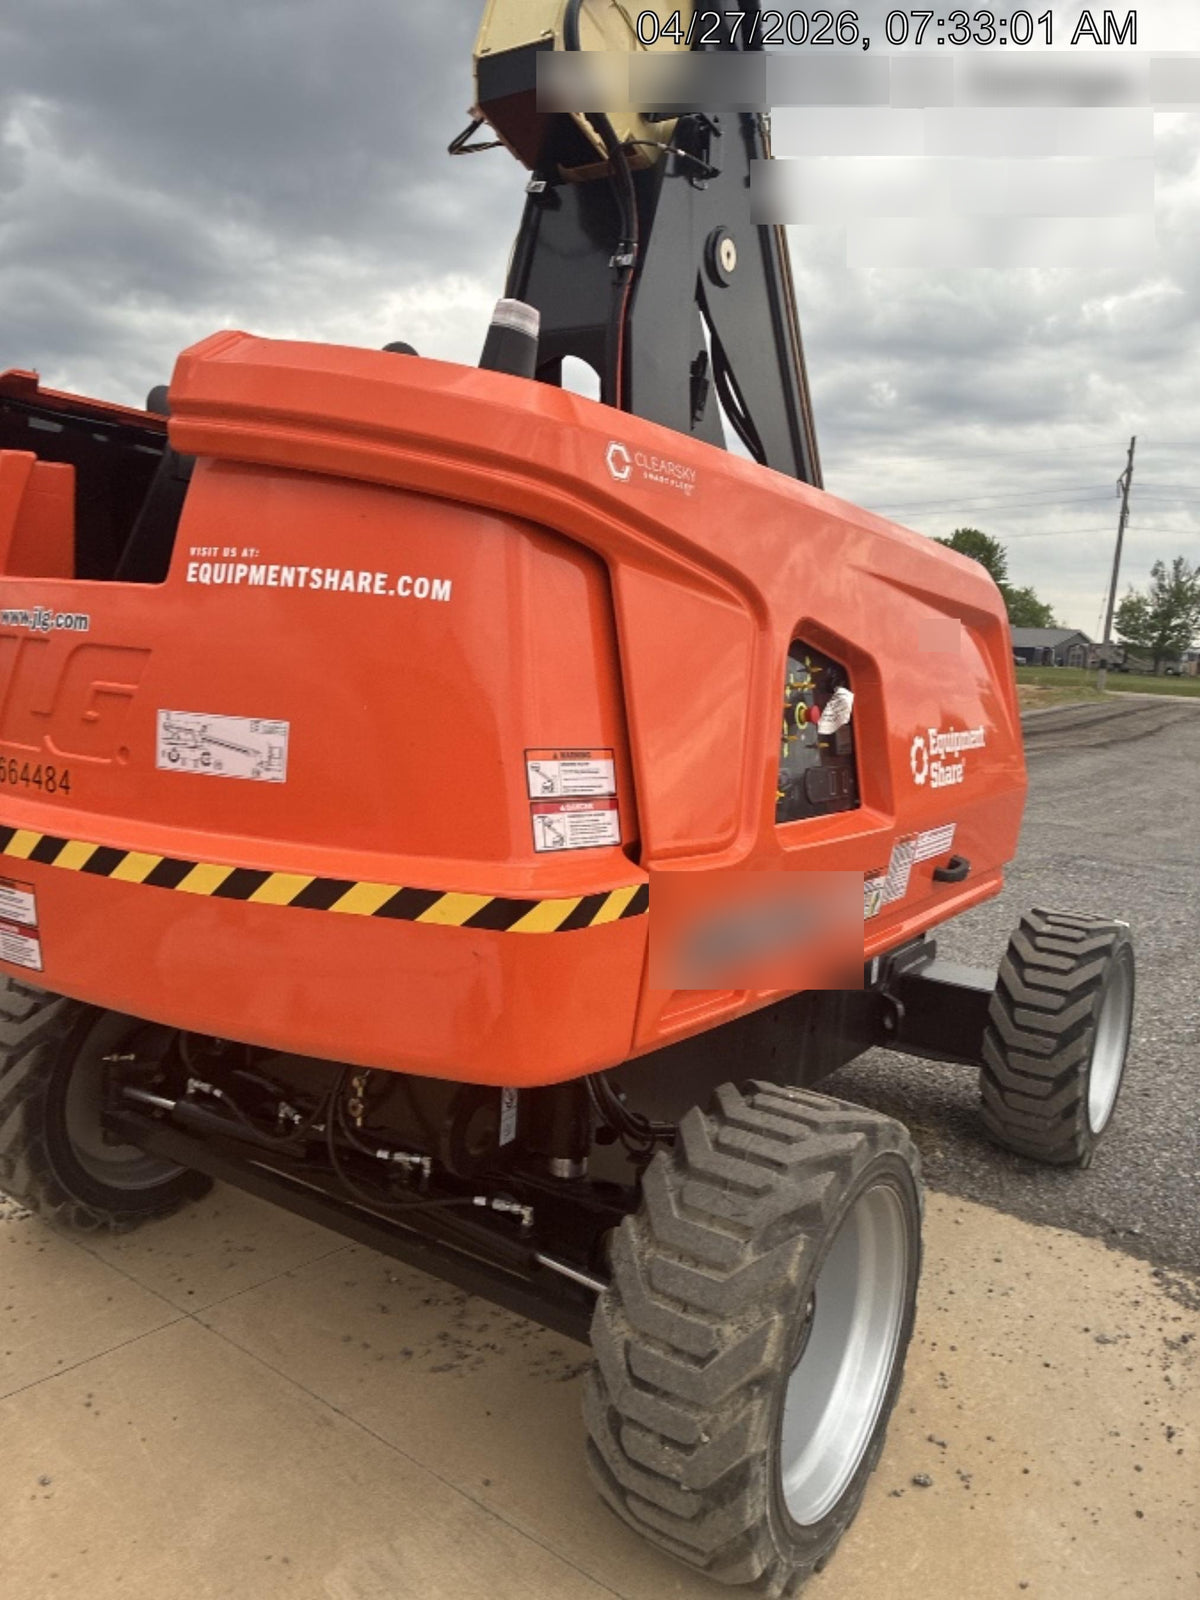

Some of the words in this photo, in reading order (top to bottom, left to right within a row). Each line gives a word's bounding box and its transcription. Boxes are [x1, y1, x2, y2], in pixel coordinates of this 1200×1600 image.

[634, 452, 696, 482] CLEARSKY
[189, 547, 219, 557] VISIT
[223, 547, 237, 557] US
[241, 547, 260, 558] AT:
[186, 561, 452, 602] EQUIPMENTSHARE.COM
[1, 606, 90, 631] www.jlg.com
[928, 725, 986, 760] Equipment
[930, 760, 964, 789] Share
